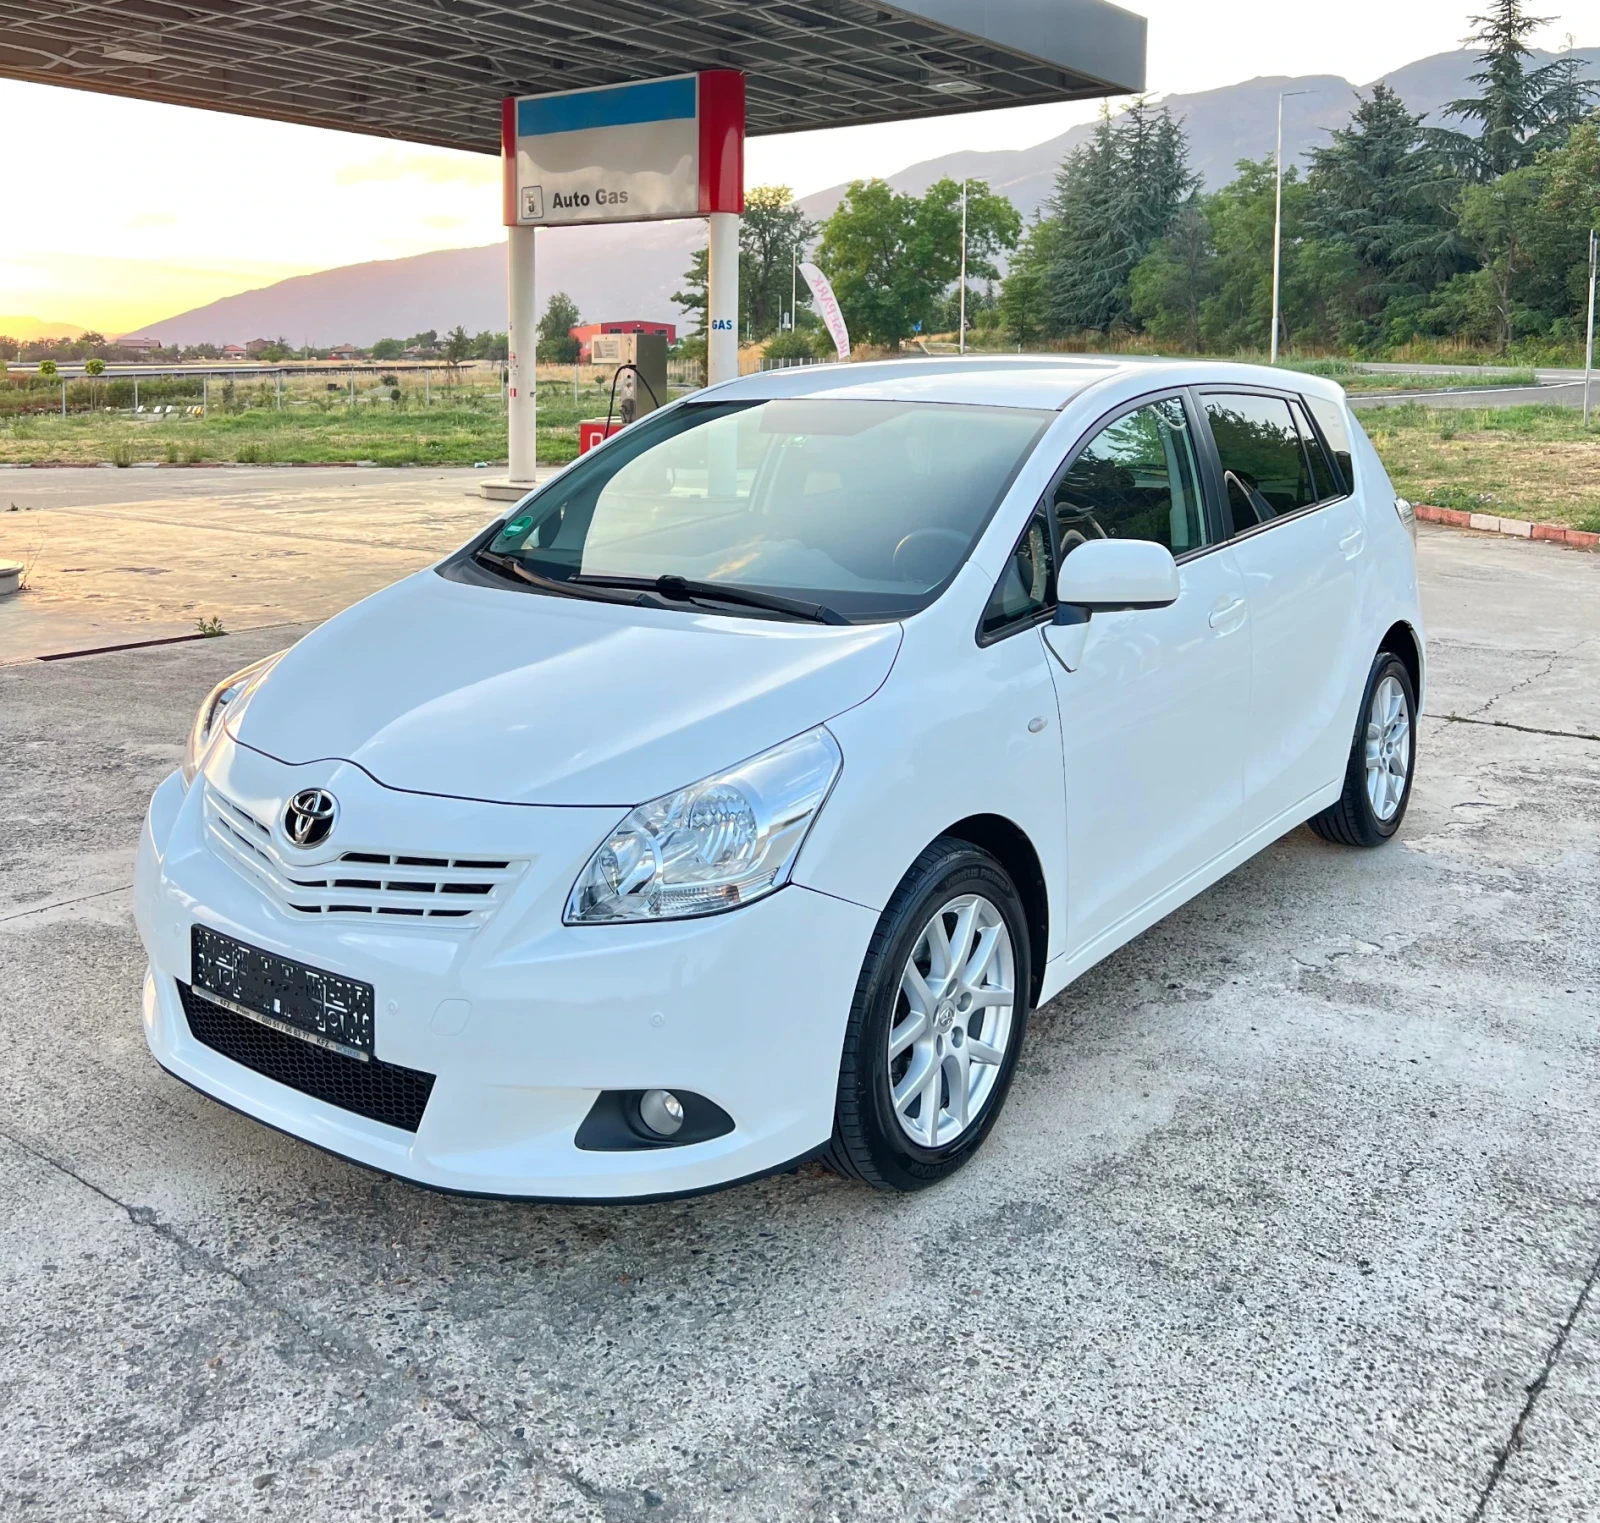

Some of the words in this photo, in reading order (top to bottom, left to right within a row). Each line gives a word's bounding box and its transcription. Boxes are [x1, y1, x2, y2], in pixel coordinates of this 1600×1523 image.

[552, 192, 590, 209] Auto
[595, 188, 629, 205] Gas
[712, 319, 733, 330] GAS
[316, 1036, 329, 1047] KFZ
